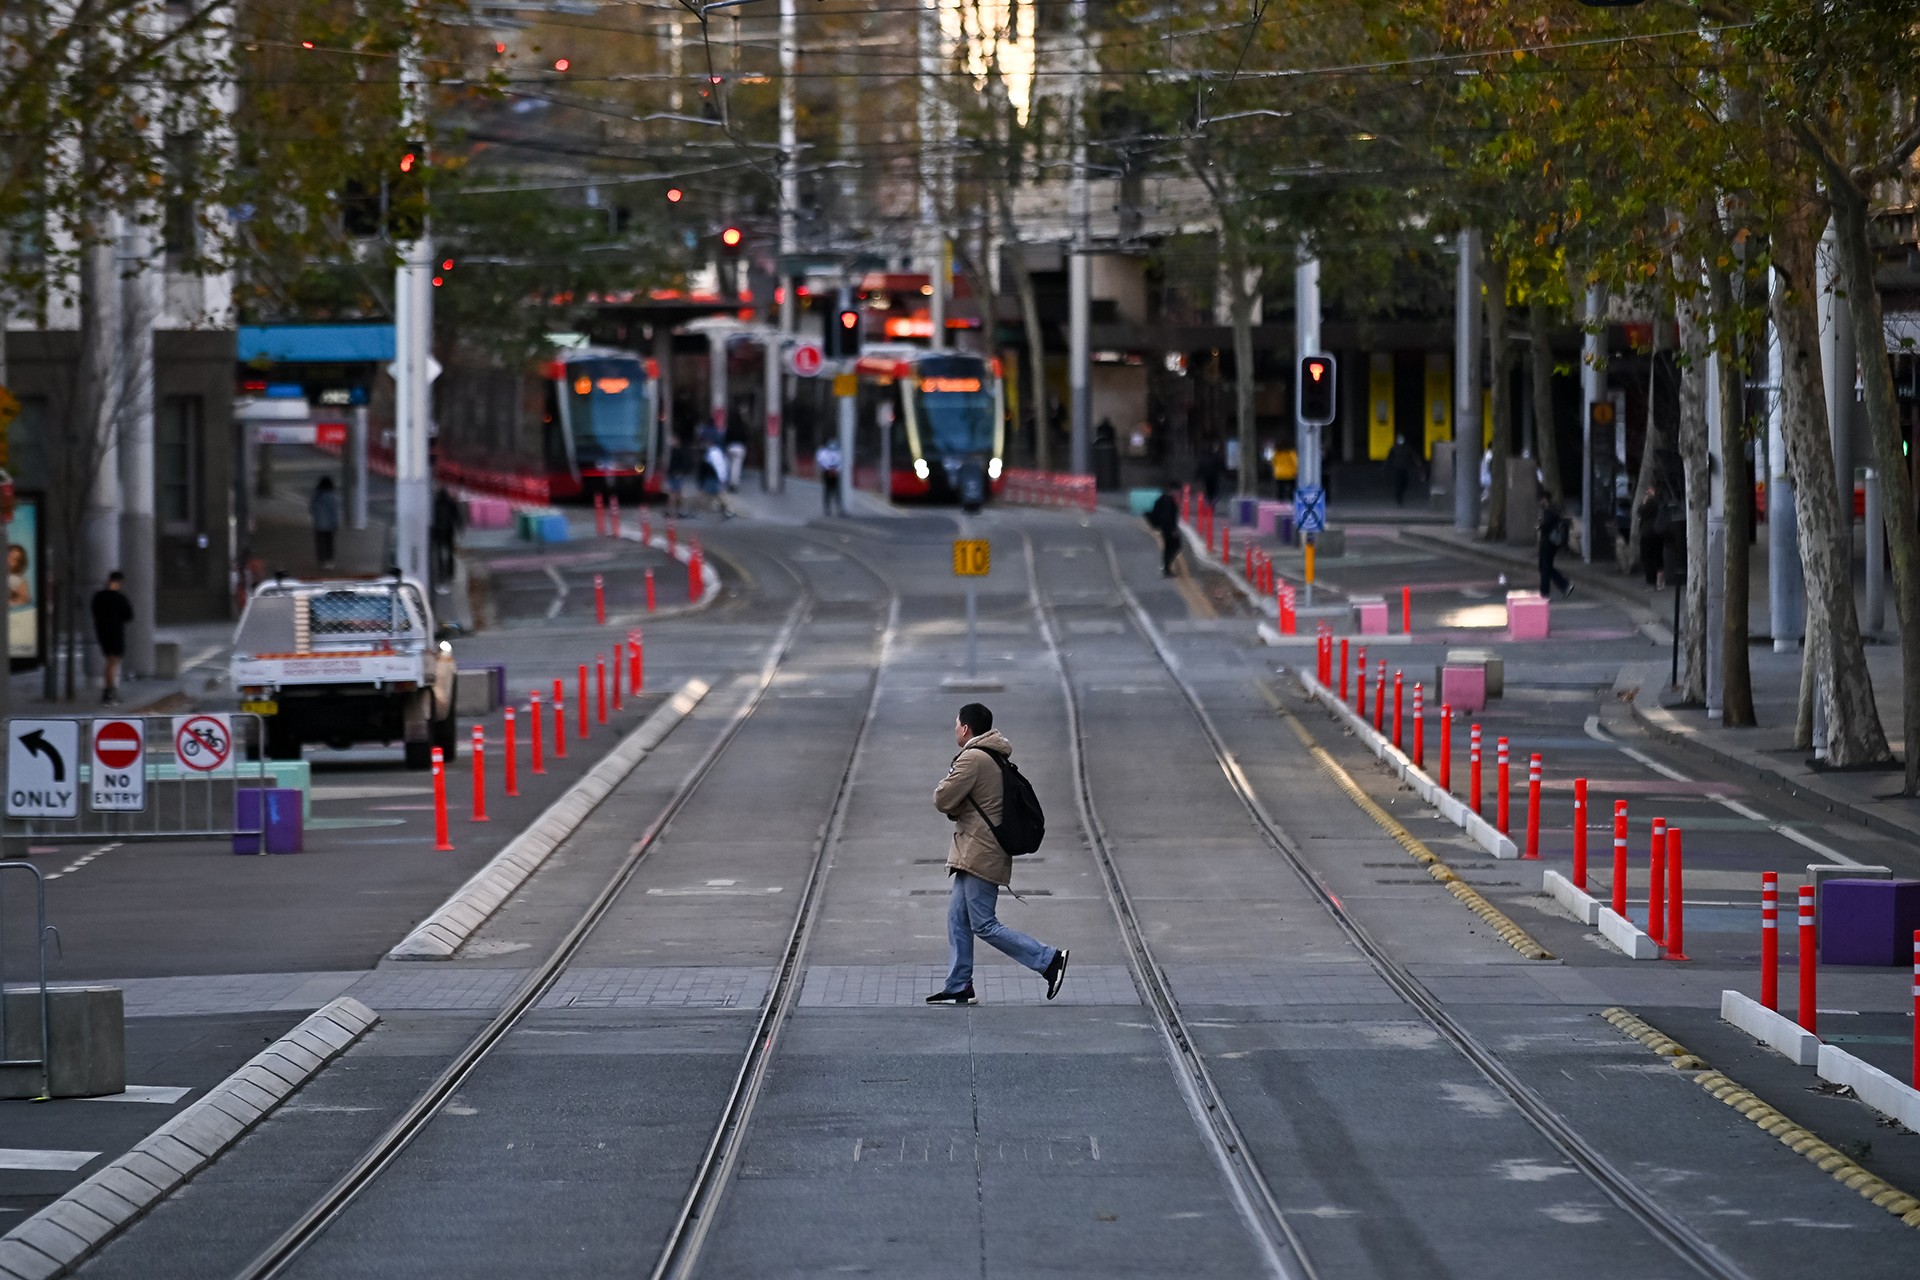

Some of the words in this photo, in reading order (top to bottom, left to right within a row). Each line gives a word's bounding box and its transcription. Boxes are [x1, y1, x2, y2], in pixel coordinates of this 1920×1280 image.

[960, 546, 987, 572] 10
[104, 774, 130, 788] NO
[11, 791, 72, 808] ONLY
[94, 792, 140, 804] ENTRY
